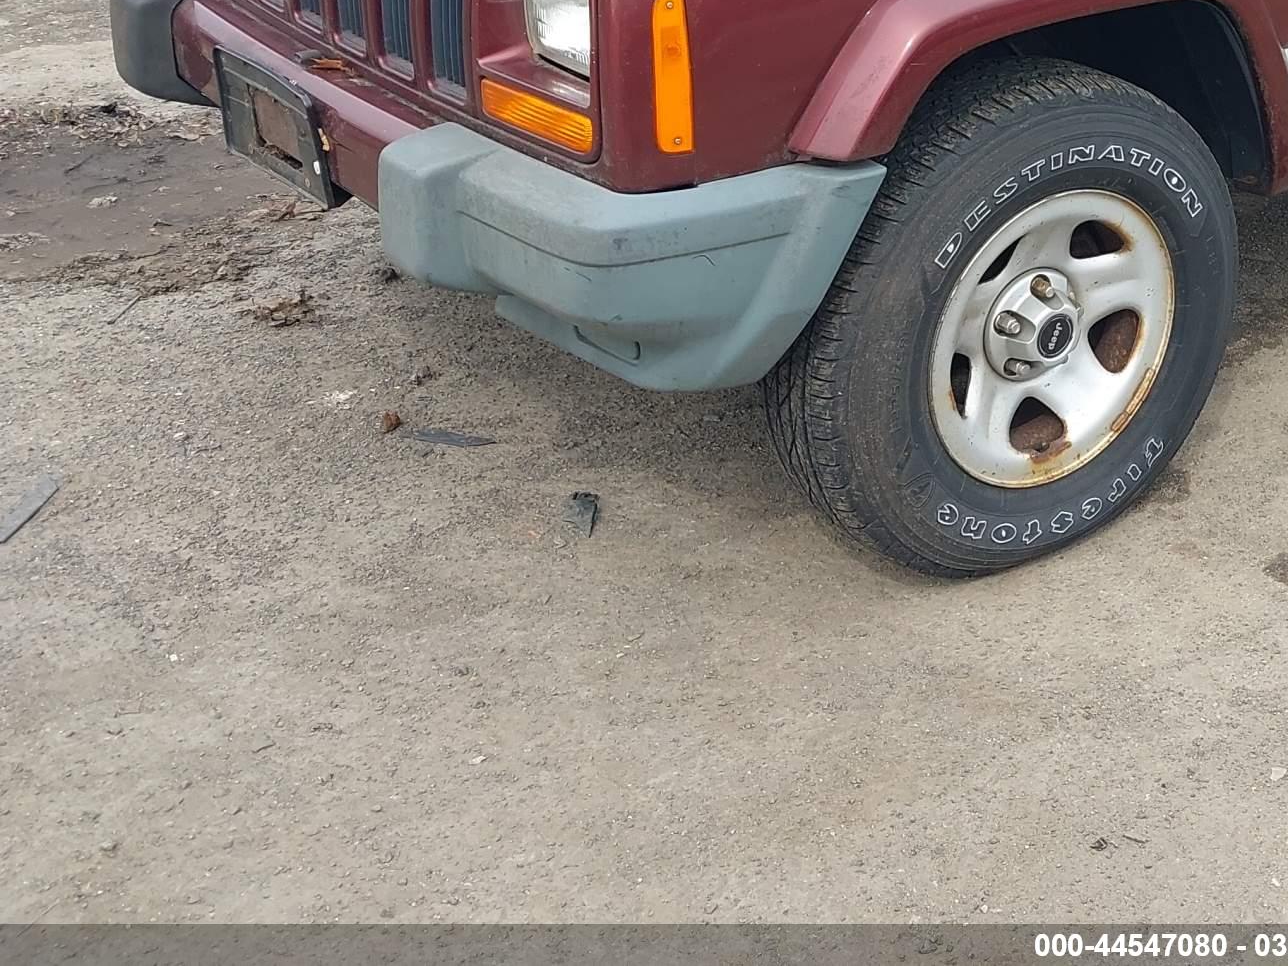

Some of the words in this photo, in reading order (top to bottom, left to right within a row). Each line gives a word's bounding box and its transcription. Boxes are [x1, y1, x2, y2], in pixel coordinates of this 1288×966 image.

[934, 143, 1203, 270] DESTINATION
[1047, 322, 1063, 350] Jeep
[936, 436, 1165, 545] Firestone
